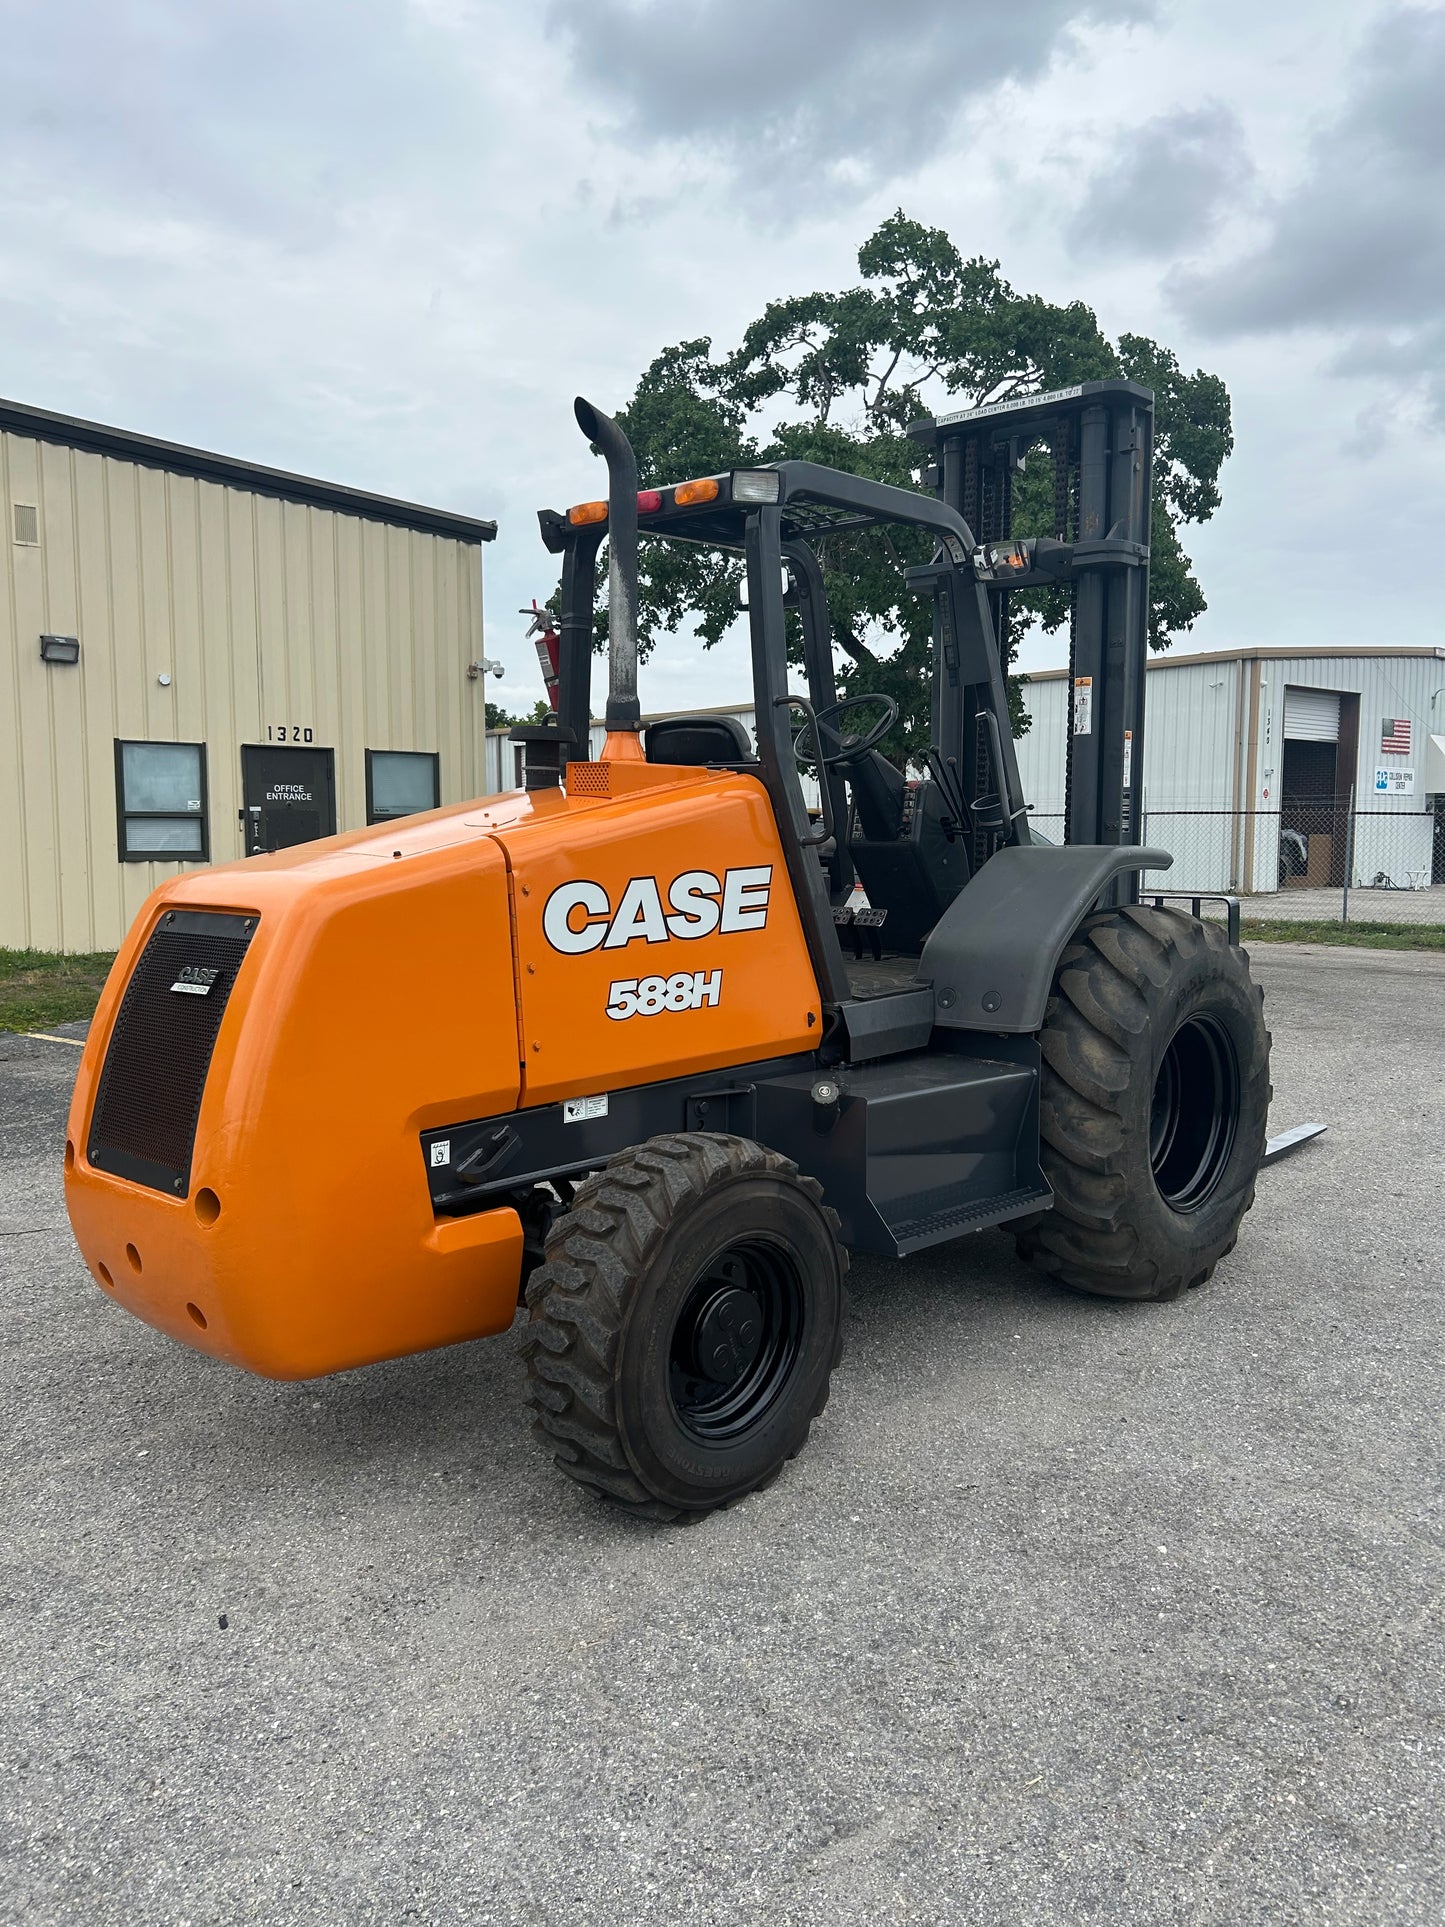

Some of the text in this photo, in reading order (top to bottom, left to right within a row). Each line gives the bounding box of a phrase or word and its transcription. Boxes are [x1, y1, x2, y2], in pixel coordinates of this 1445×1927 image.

[937, 415, 959, 425] CAPACITY
[975, 408, 988, 417] LOAD
[988, 404, 1006, 414] CENTER
[268, 725, 313, 742] 1320
[266, 792, 313, 801] ENTRANCE
[273, 784, 305, 793] OFFICE
[542, 864, 773, 956] CASE
[179, 966, 219, 985] CASE
[178, 985, 207, 993] CONSTRUCTION
[605, 968, 724, 1021] 588H
